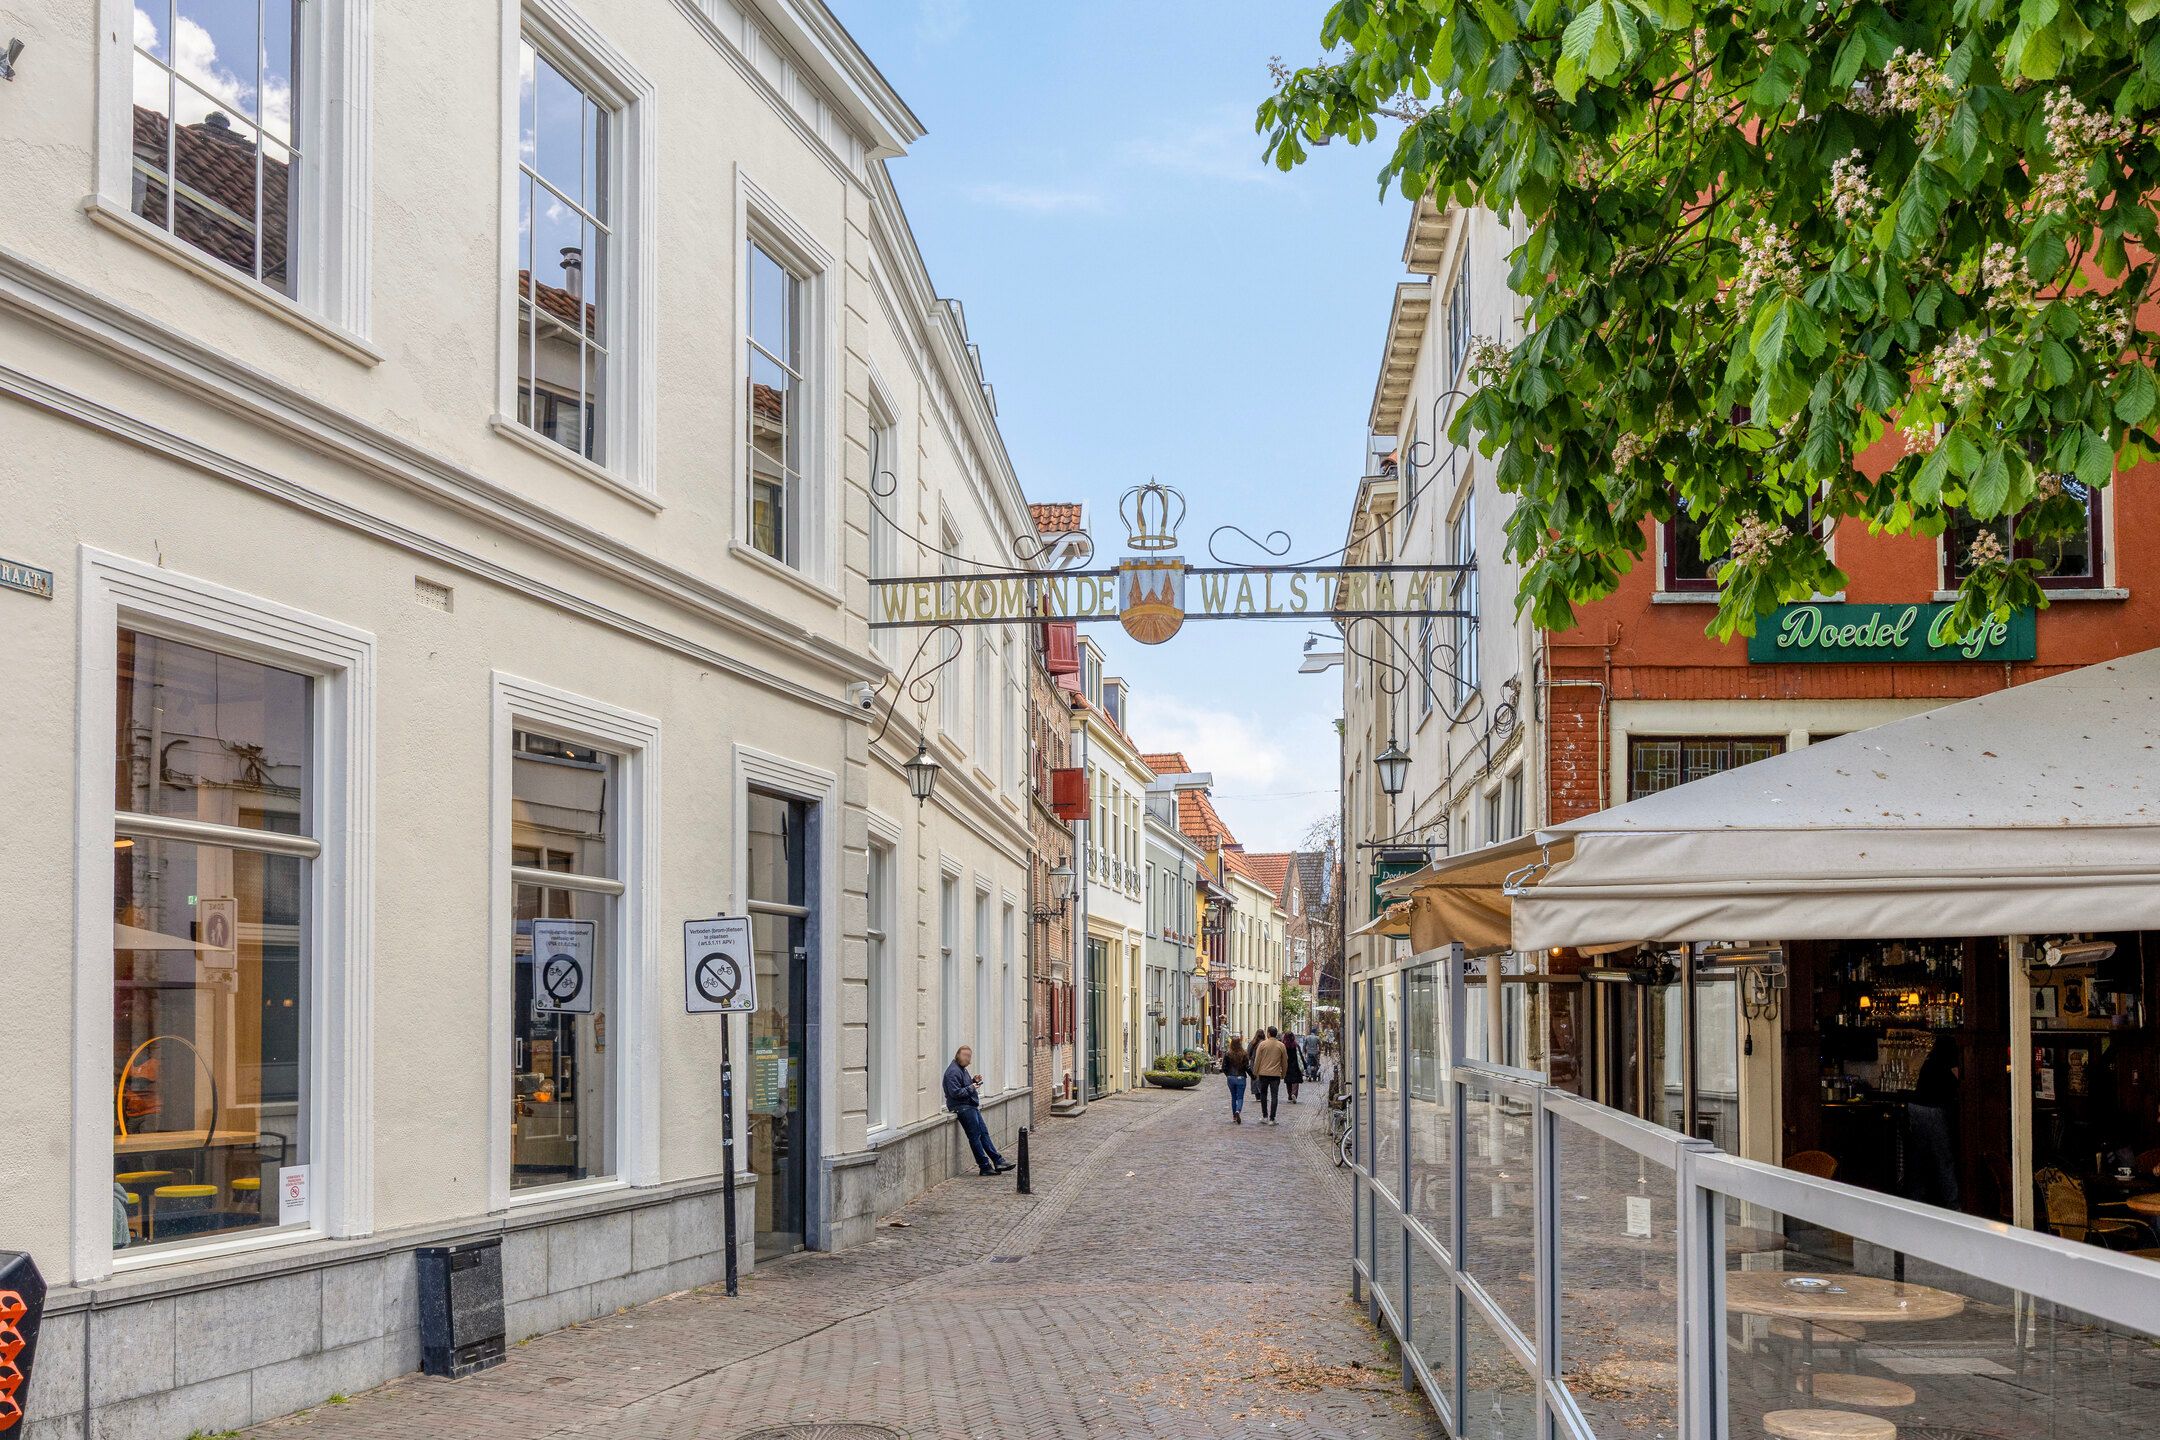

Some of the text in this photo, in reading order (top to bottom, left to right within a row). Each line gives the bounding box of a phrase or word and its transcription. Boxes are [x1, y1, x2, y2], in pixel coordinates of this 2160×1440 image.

[880, 571, 1458, 623] WELKOM IN DE WALSTRAAT
[1777, 606, 1918, 648] Doedel
